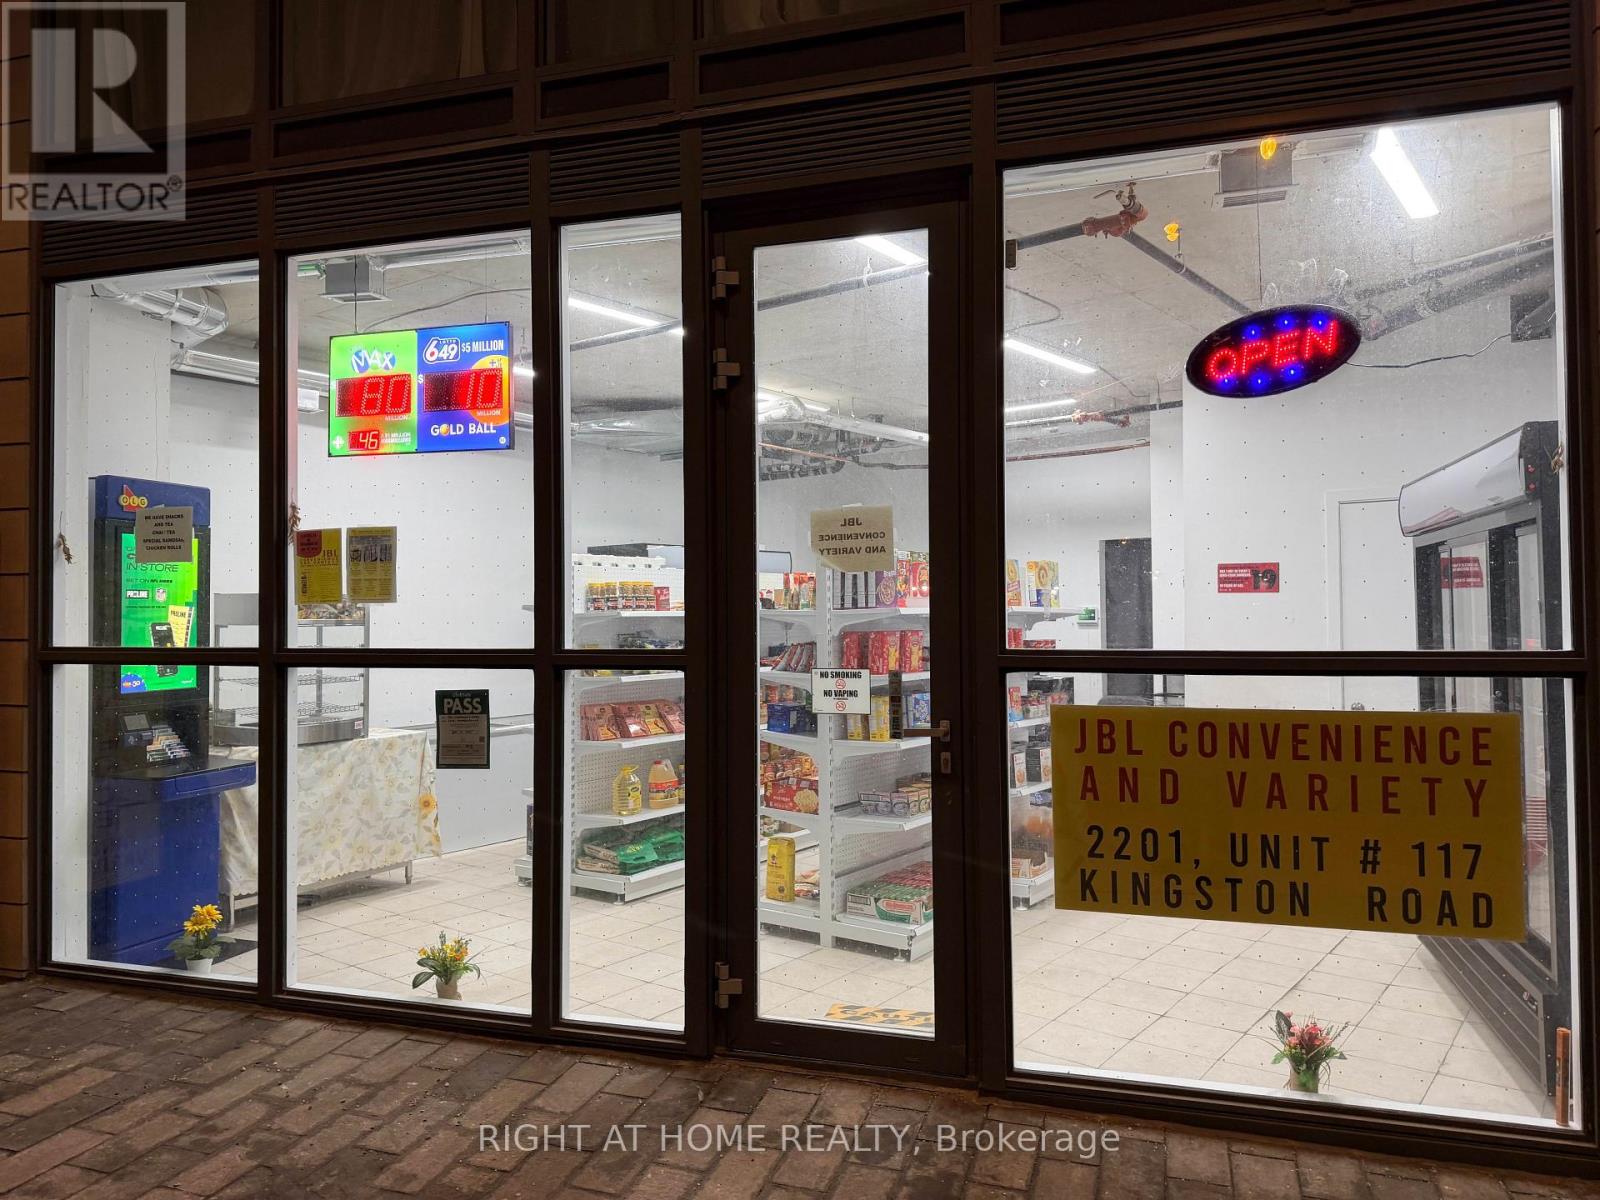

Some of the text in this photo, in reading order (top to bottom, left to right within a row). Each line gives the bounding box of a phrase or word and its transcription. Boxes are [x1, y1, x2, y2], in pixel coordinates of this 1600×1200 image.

[461, 342, 471, 353] $5
[472, 339, 504, 353] MILLION
[1205, 320, 1339, 380] OPEN
[352, 350, 396, 374] MAX
[430, 422, 497, 436] GOLD BALL
[359, 431, 379, 450] 46
[140, 563, 179, 573] STORE
[819, 671, 862, 679] NO SMOKING
[834, 689, 858, 698] VAPING
[443, 697, 482, 714] PASS
[1074, 718, 1493, 767] JBL CONVENIENCE
[1080, 765, 1488, 818] AND VARIETY
[1086, 824, 1483, 881] 2201, UNIT # 117
[1080, 868, 1494, 929] KINGSTON ROAD
